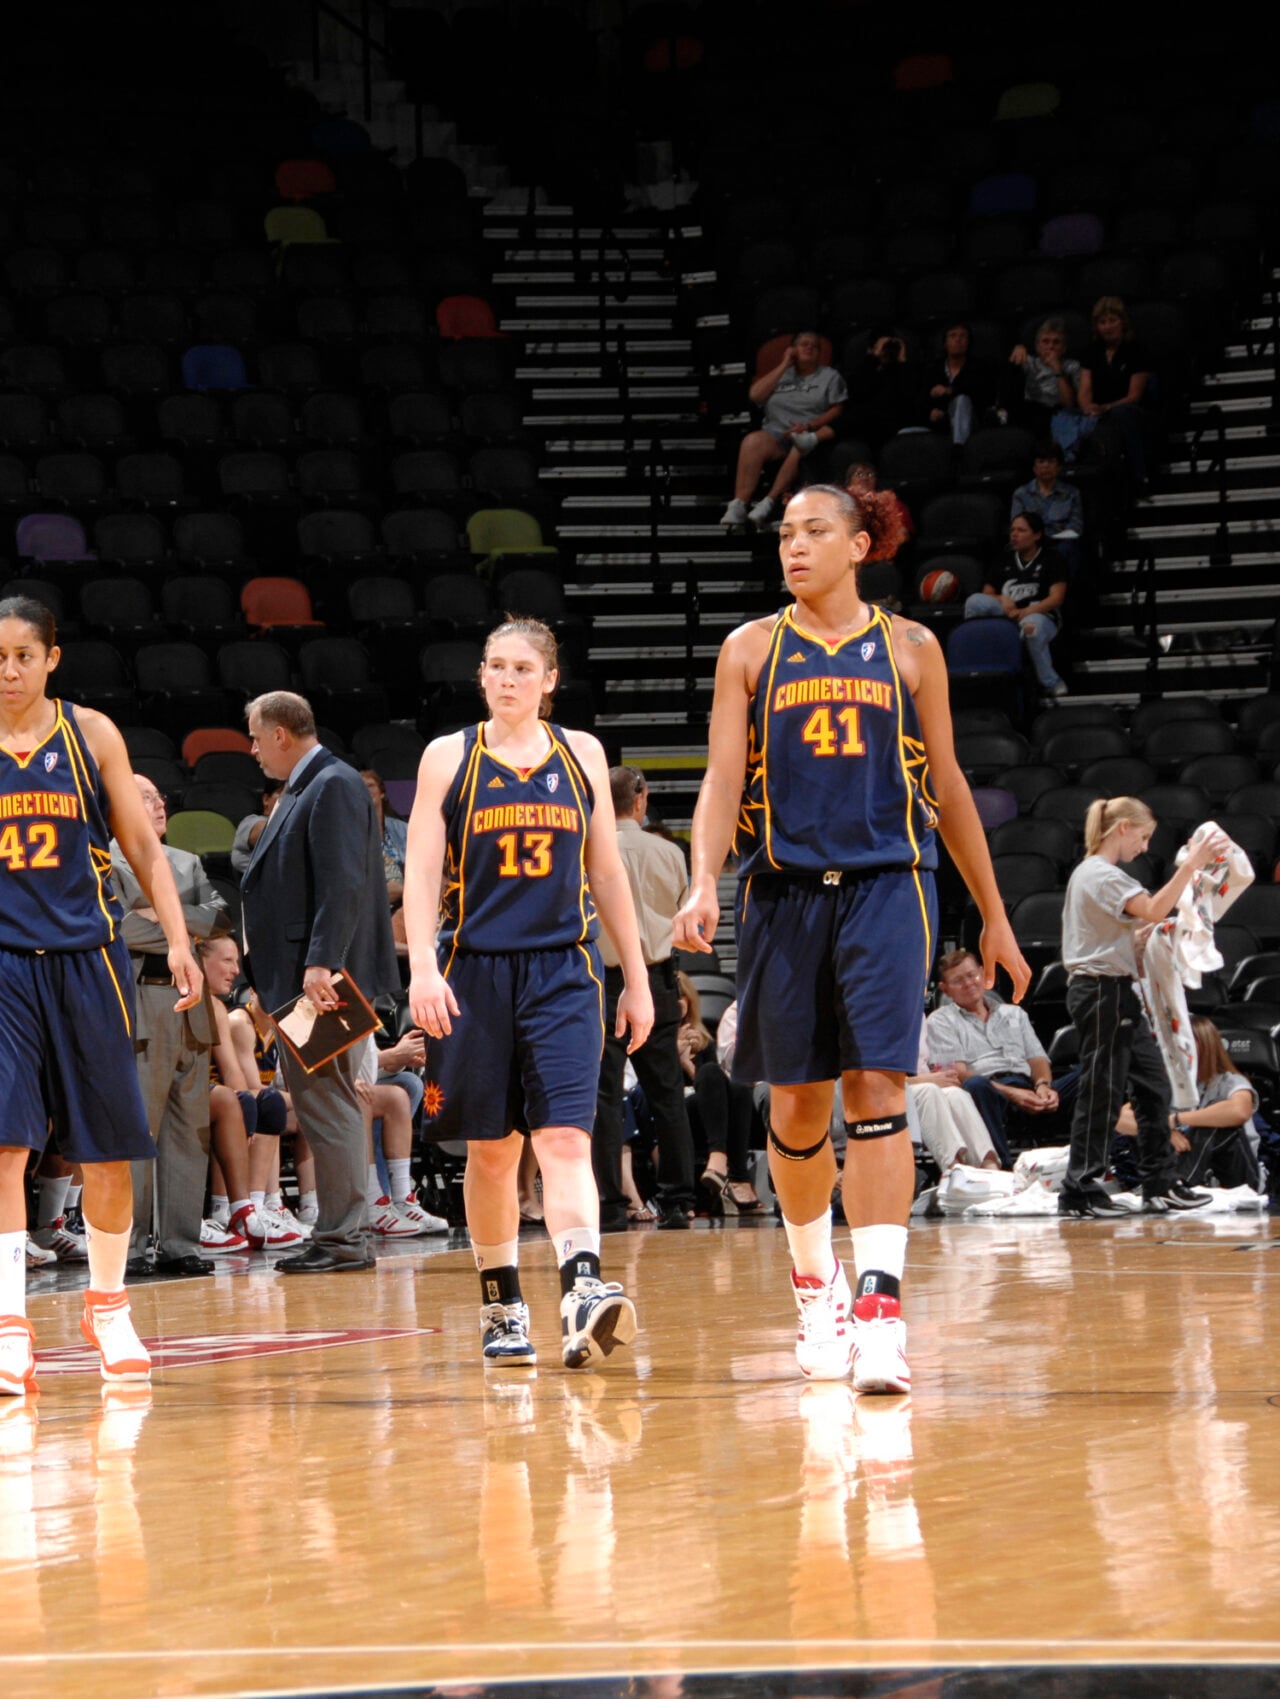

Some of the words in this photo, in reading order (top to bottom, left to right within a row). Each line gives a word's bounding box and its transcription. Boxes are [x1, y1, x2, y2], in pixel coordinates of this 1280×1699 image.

[773, 676, 893, 713] CONNECTICUT
[801, 705, 867, 757] 41
[472, 801, 579, 835] CONNECTICUT
[496, 831, 554, 878] 13
